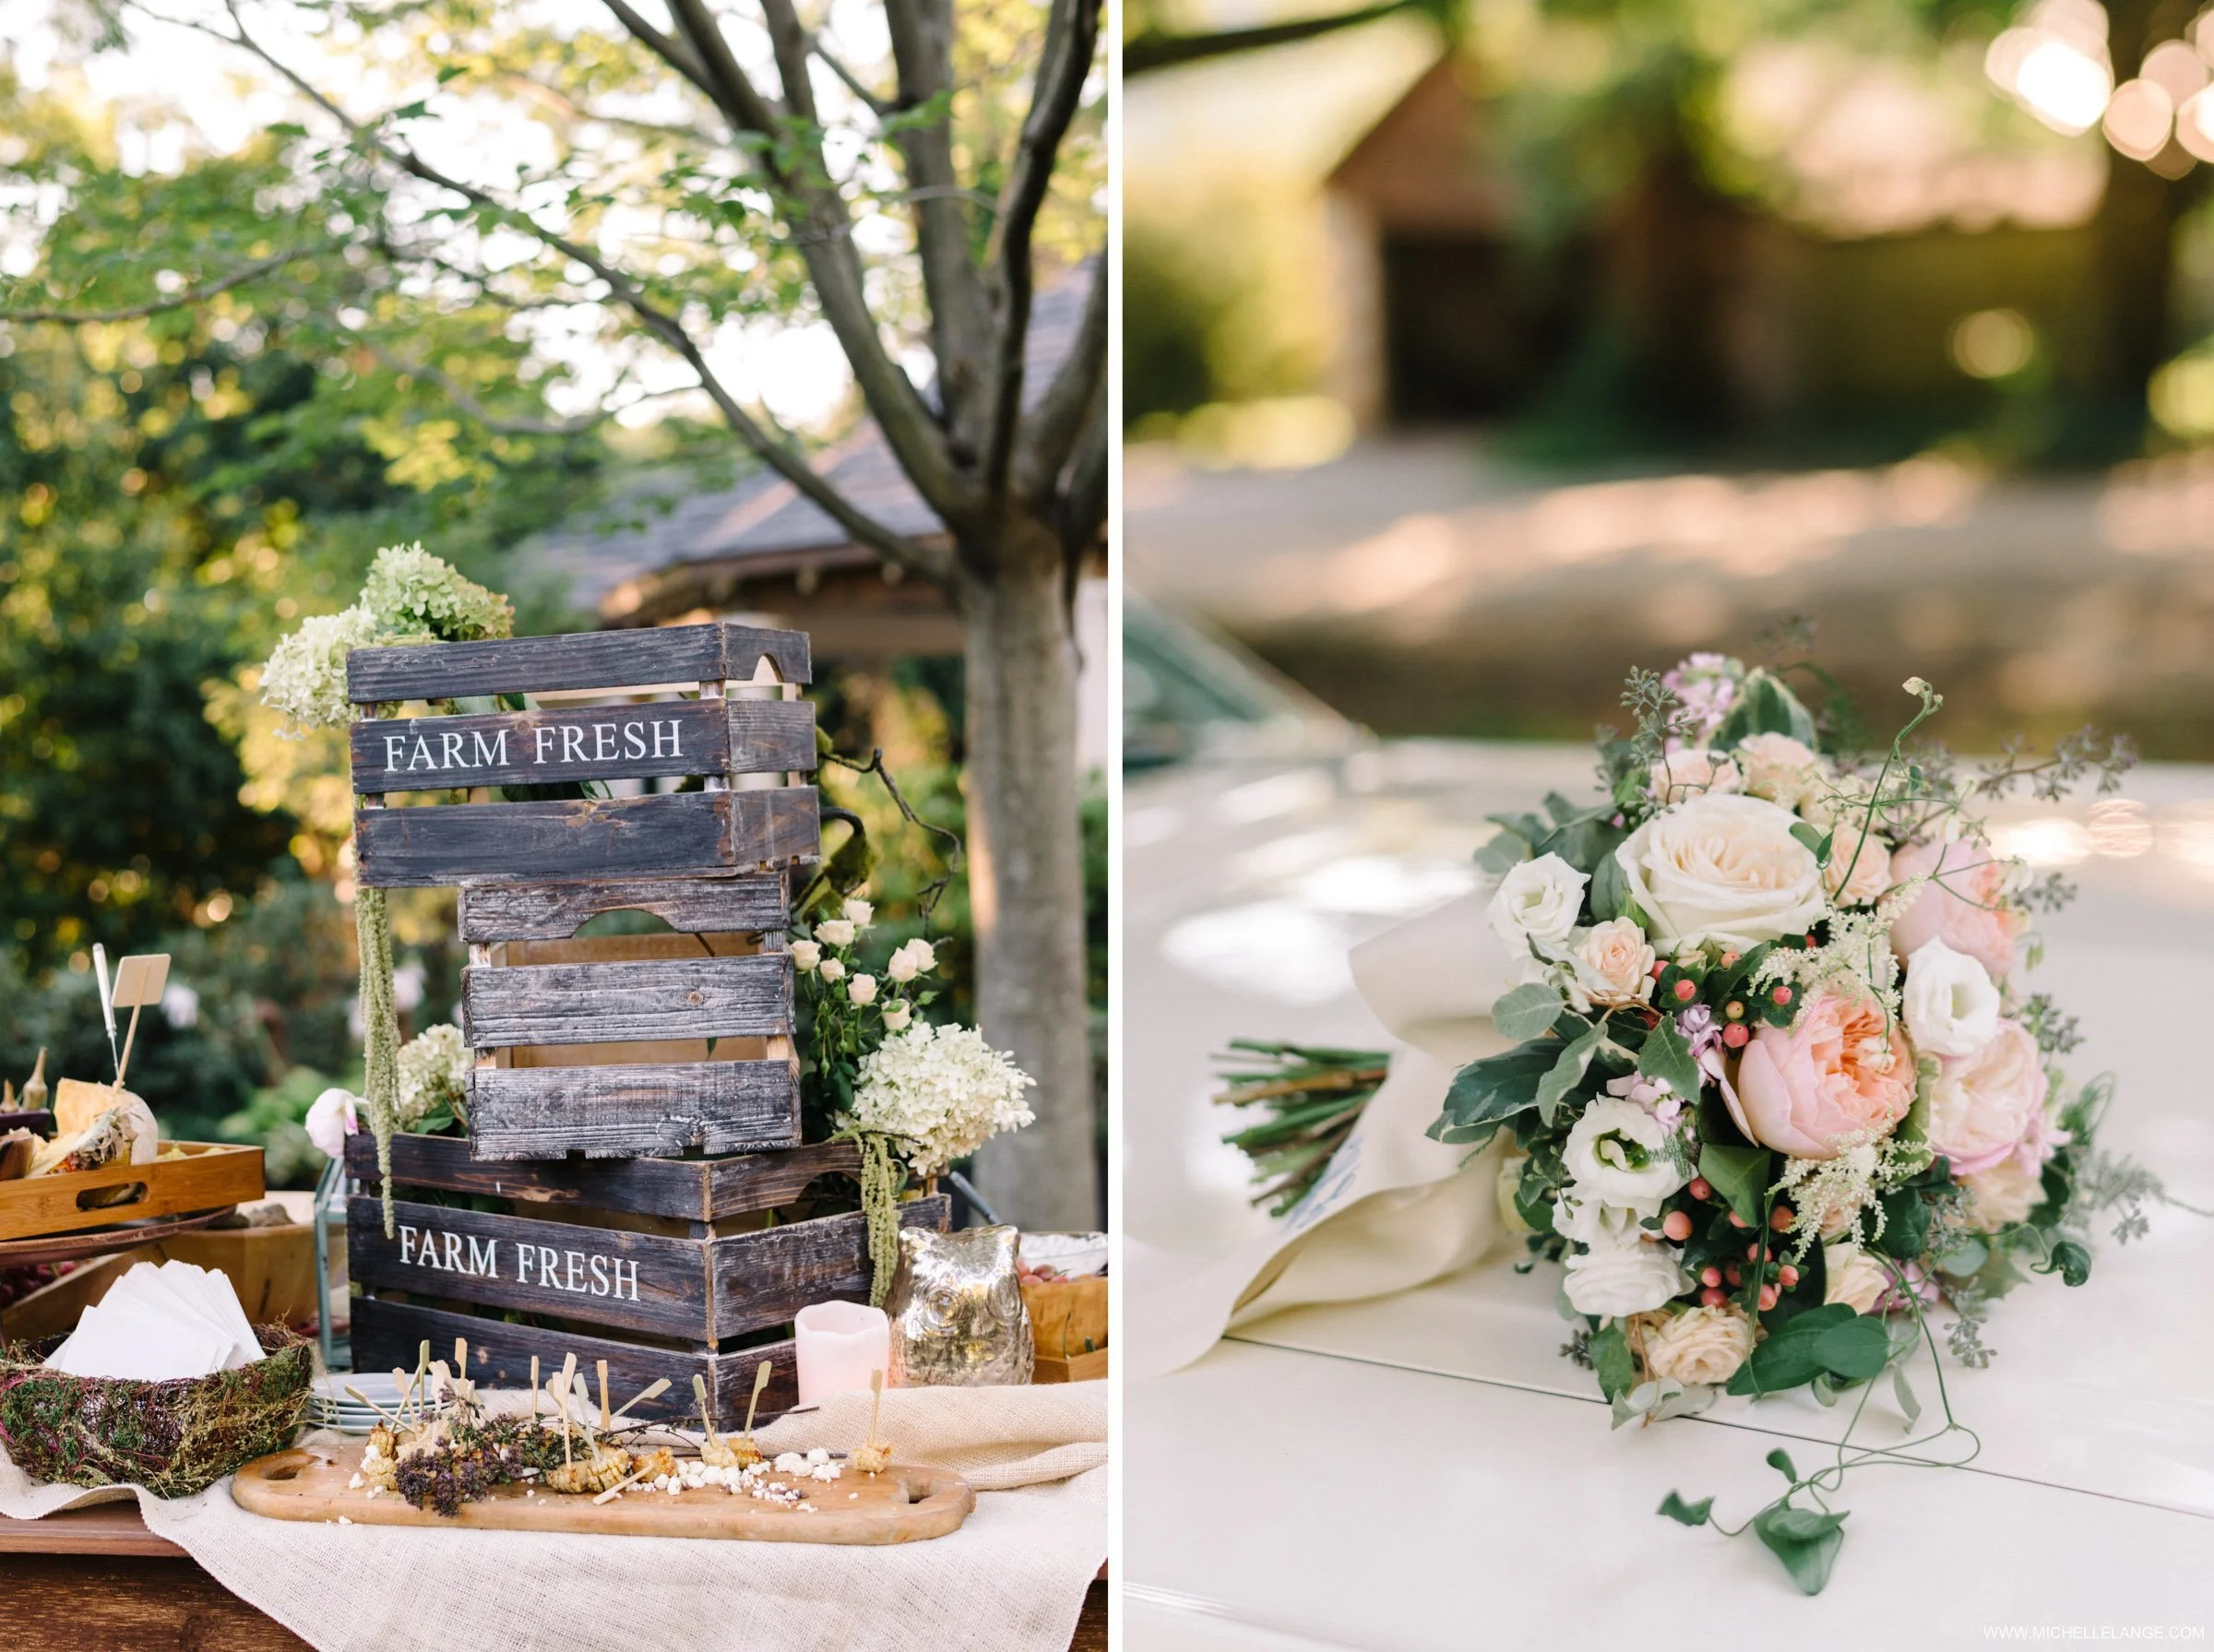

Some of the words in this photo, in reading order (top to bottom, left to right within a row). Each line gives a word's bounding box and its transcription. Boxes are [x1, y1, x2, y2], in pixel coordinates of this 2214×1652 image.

[384, 729, 509, 771] FARM
[533, 719, 684, 764] FRESH
[399, 1225, 498, 1278] FARM
[516, 1242, 640, 1301] FRESH
